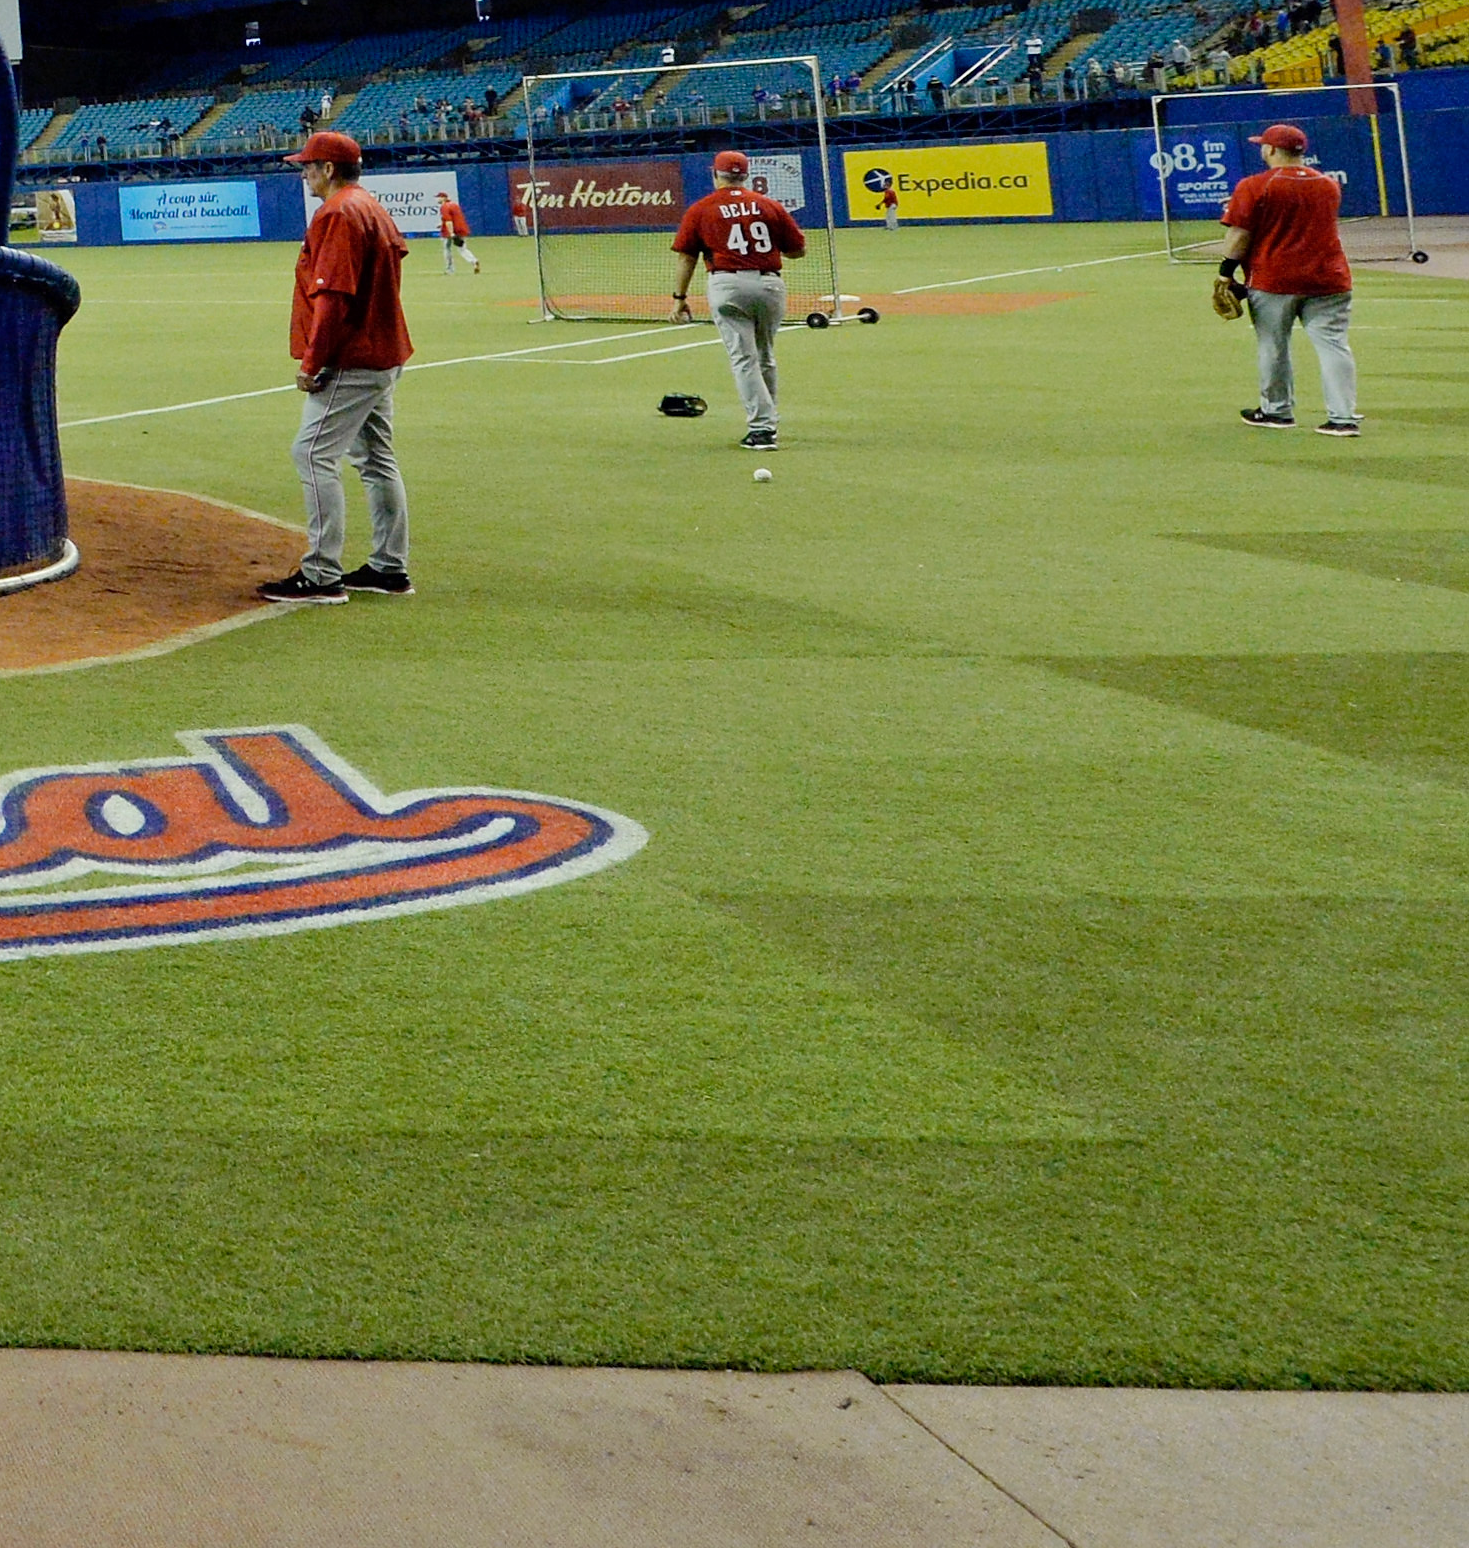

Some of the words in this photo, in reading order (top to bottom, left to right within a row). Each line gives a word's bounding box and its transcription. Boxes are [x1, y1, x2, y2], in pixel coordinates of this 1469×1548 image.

[1202, 140, 1226, 152] fm
[1149, 143, 1227, 180] 98,5
[752, 176, 769, 195] 8
[898, 171, 1028, 194] Expedia.ca
[1177, 181, 1229, 192] SPORTS
[169, 195, 196, 207] coup
[517, 181, 564, 208] Tim
[130, 207, 179, 220] Montréal
[182, 208, 198, 218] est
[387, 204, 439, 217] vestors
[719, 202, 761, 219] BELL
[727, 221, 772, 255] 49
